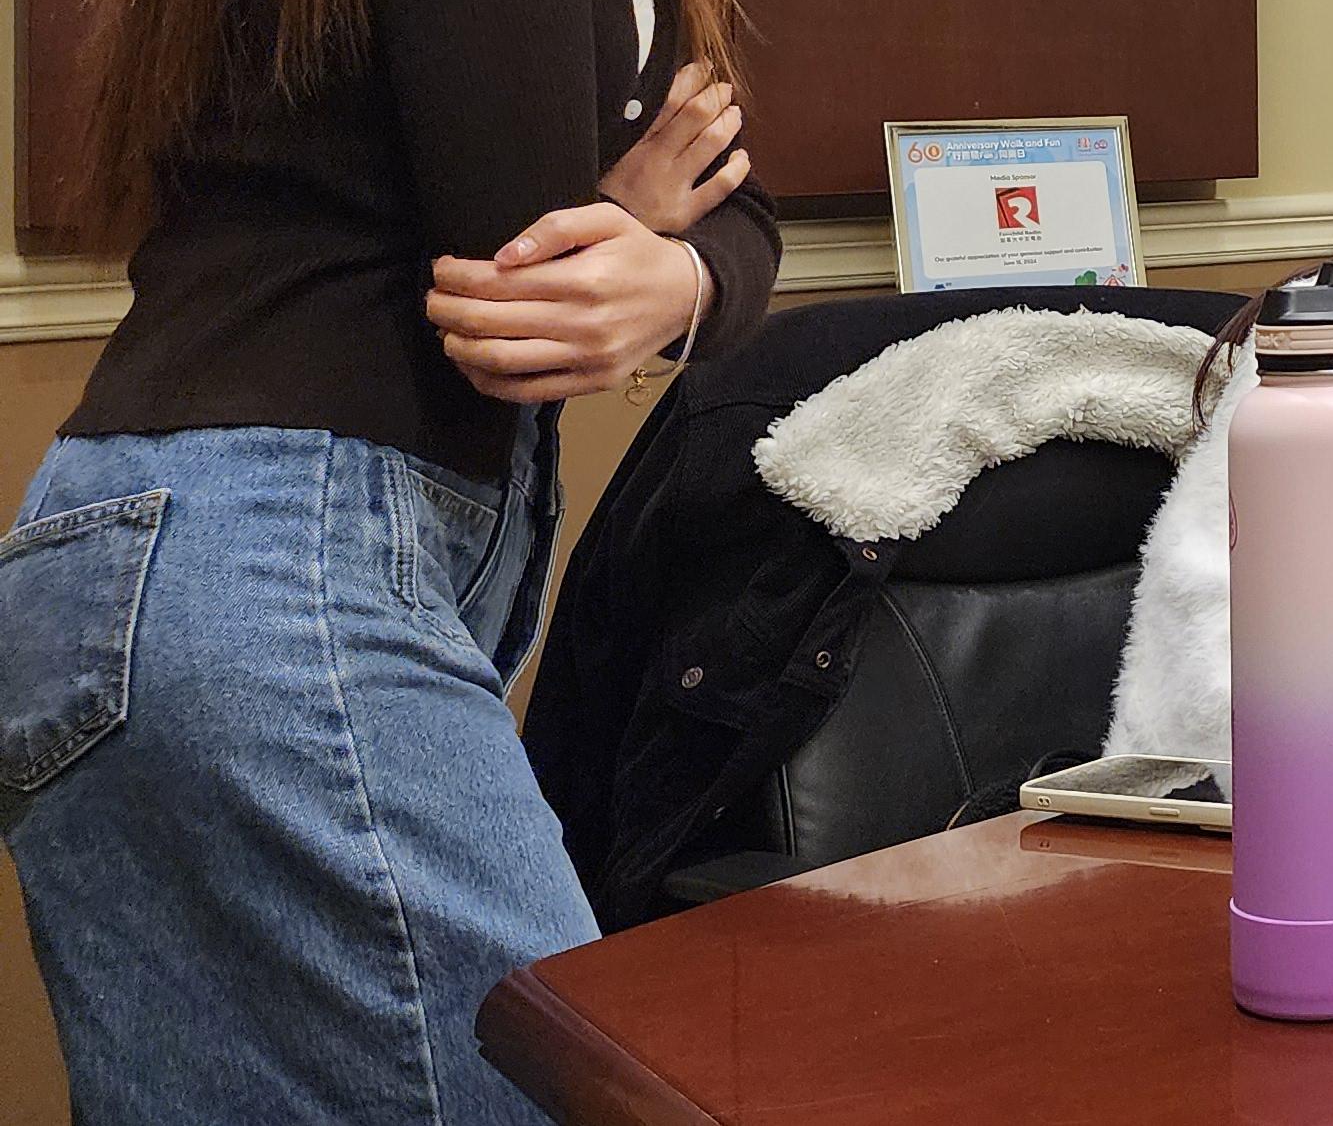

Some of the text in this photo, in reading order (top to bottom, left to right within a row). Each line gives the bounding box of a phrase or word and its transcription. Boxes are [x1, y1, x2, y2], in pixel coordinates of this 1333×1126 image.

[946, 138, 1061, 151] Anniversary Walk and Fun
